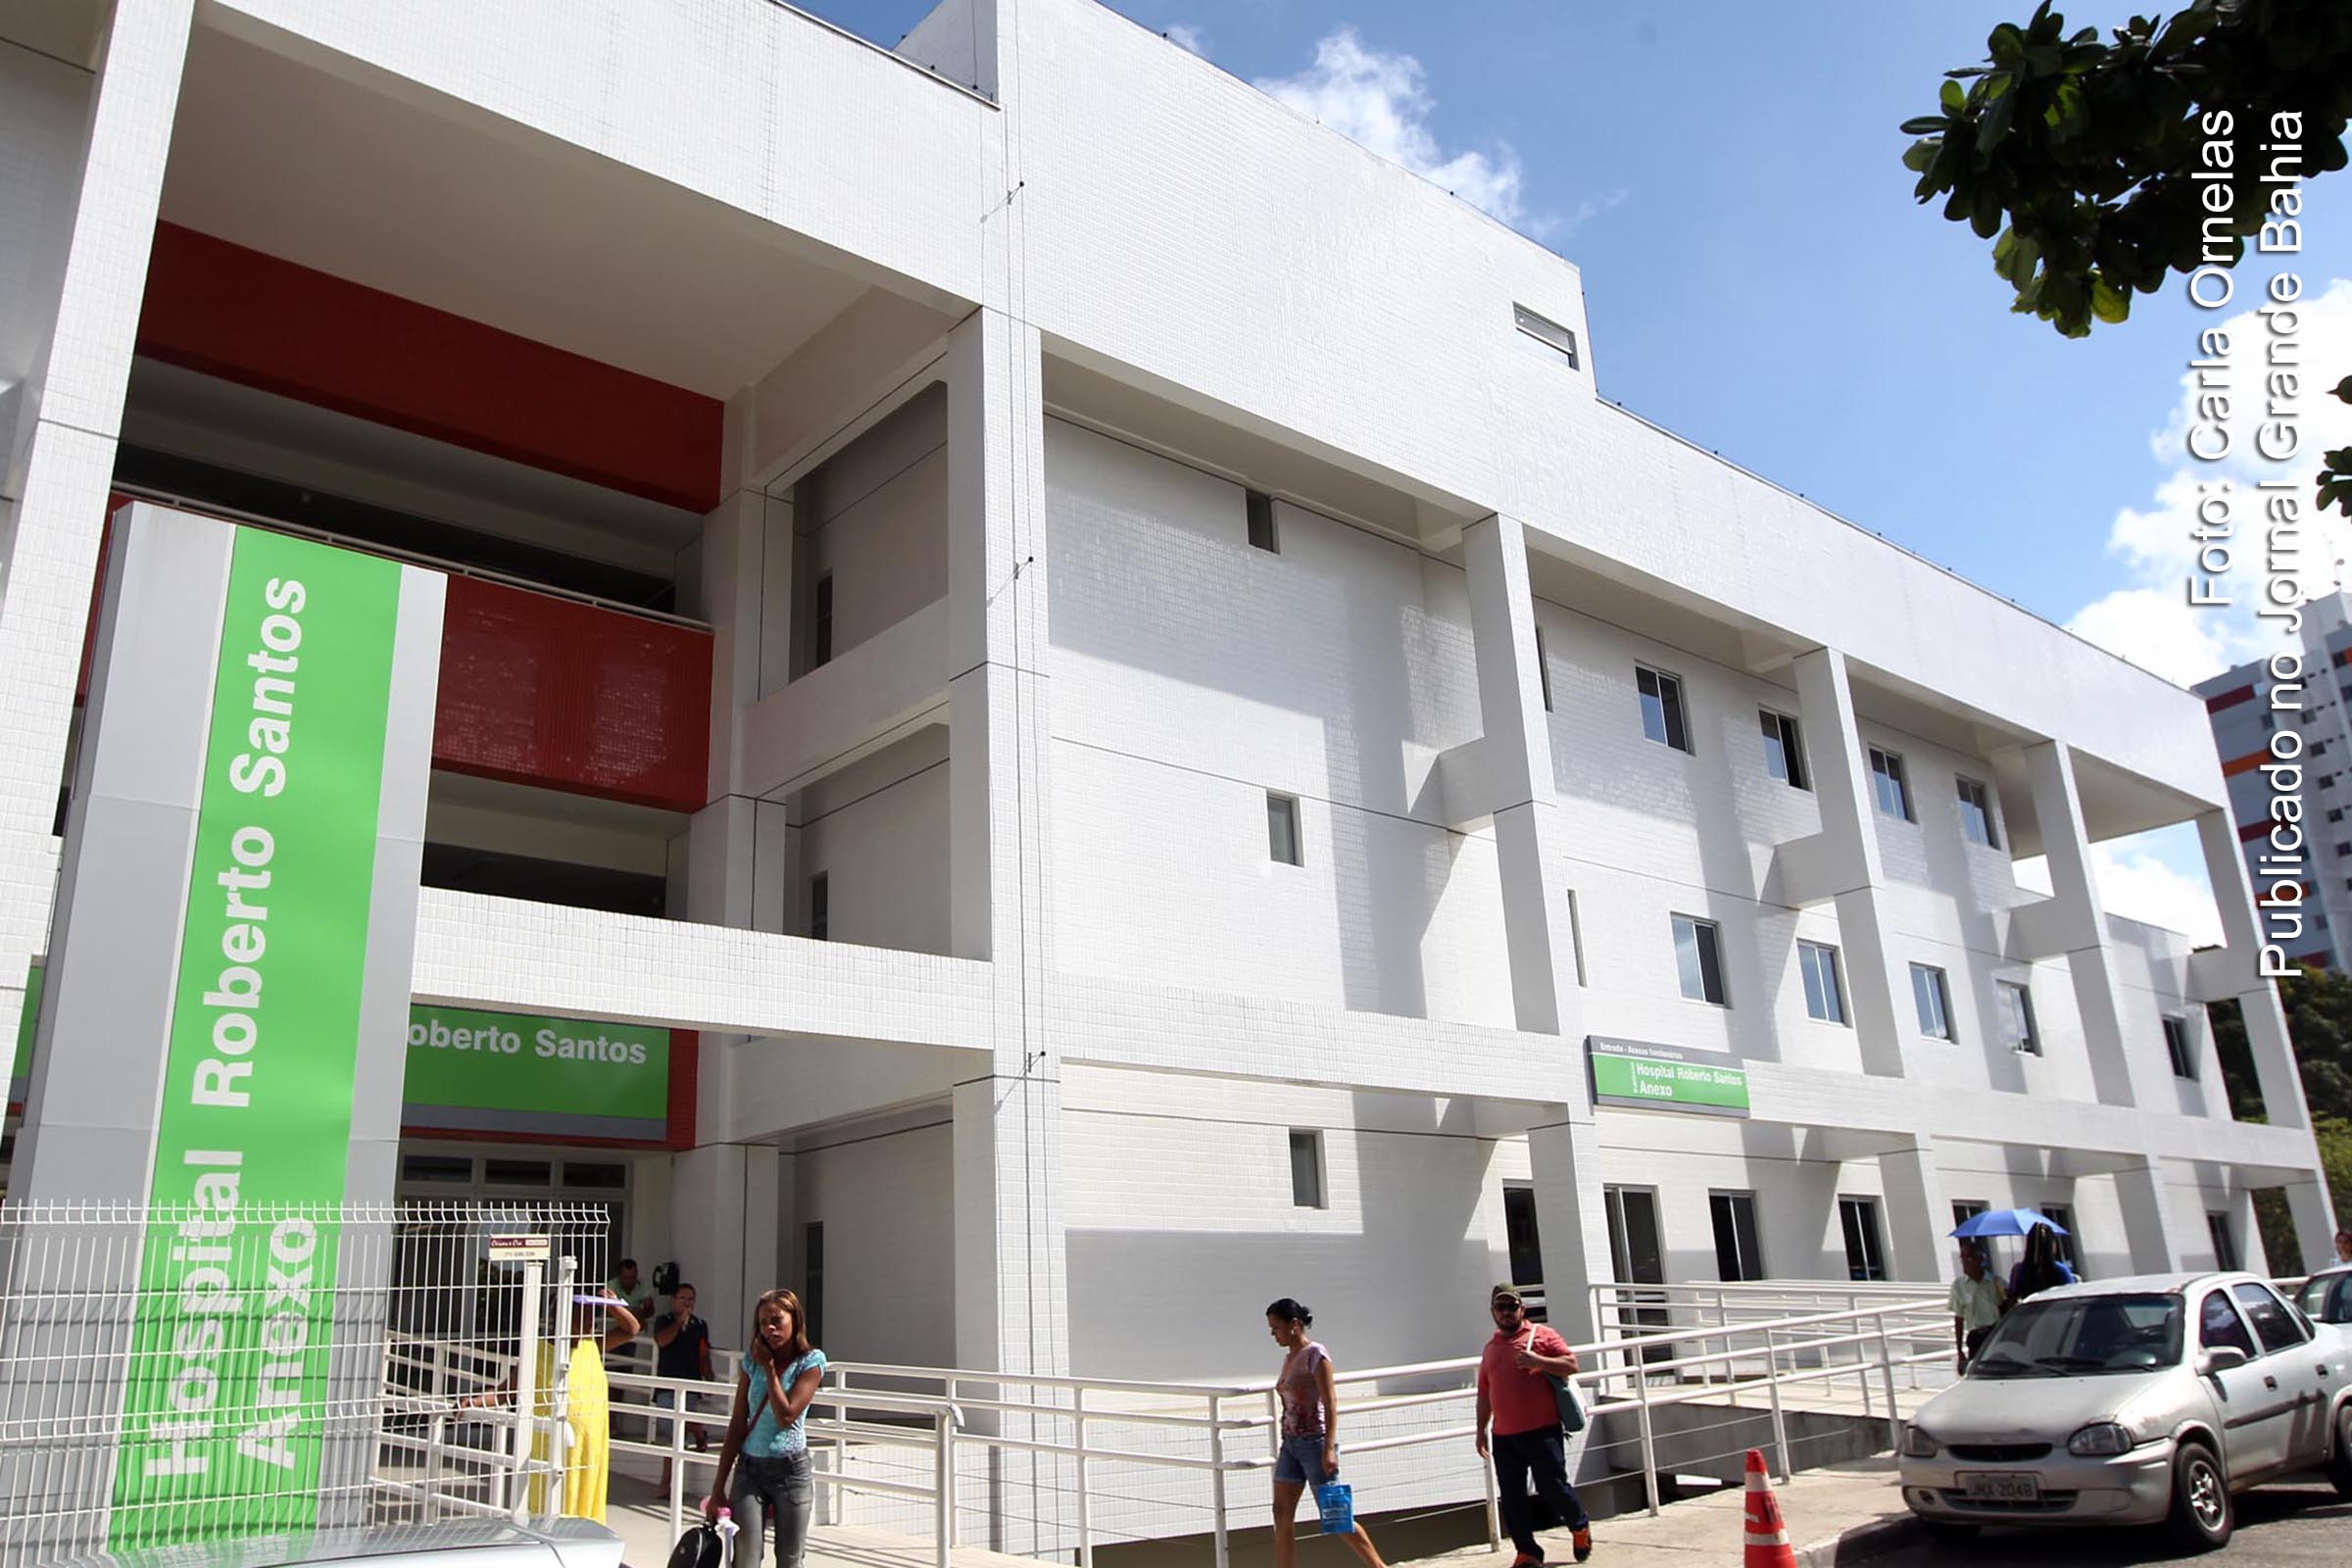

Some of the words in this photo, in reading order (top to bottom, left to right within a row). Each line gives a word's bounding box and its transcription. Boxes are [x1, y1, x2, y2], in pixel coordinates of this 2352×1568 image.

[228, 576, 307, 797] Santos
[191, 825, 274, 1107] Roberto
[408, 1019, 521, 1054] oberto
[534, 1028, 647, 1064] Santos
[1636, 1062, 1675, 1080] Hospital
[1677, 1067, 1712, 1082] Roberto
[1640, 1080, 1673, 1097] Anexo
[143, 1150, 244, 1477] Hospital
[236, 1217, 317, 1470] Anexo
